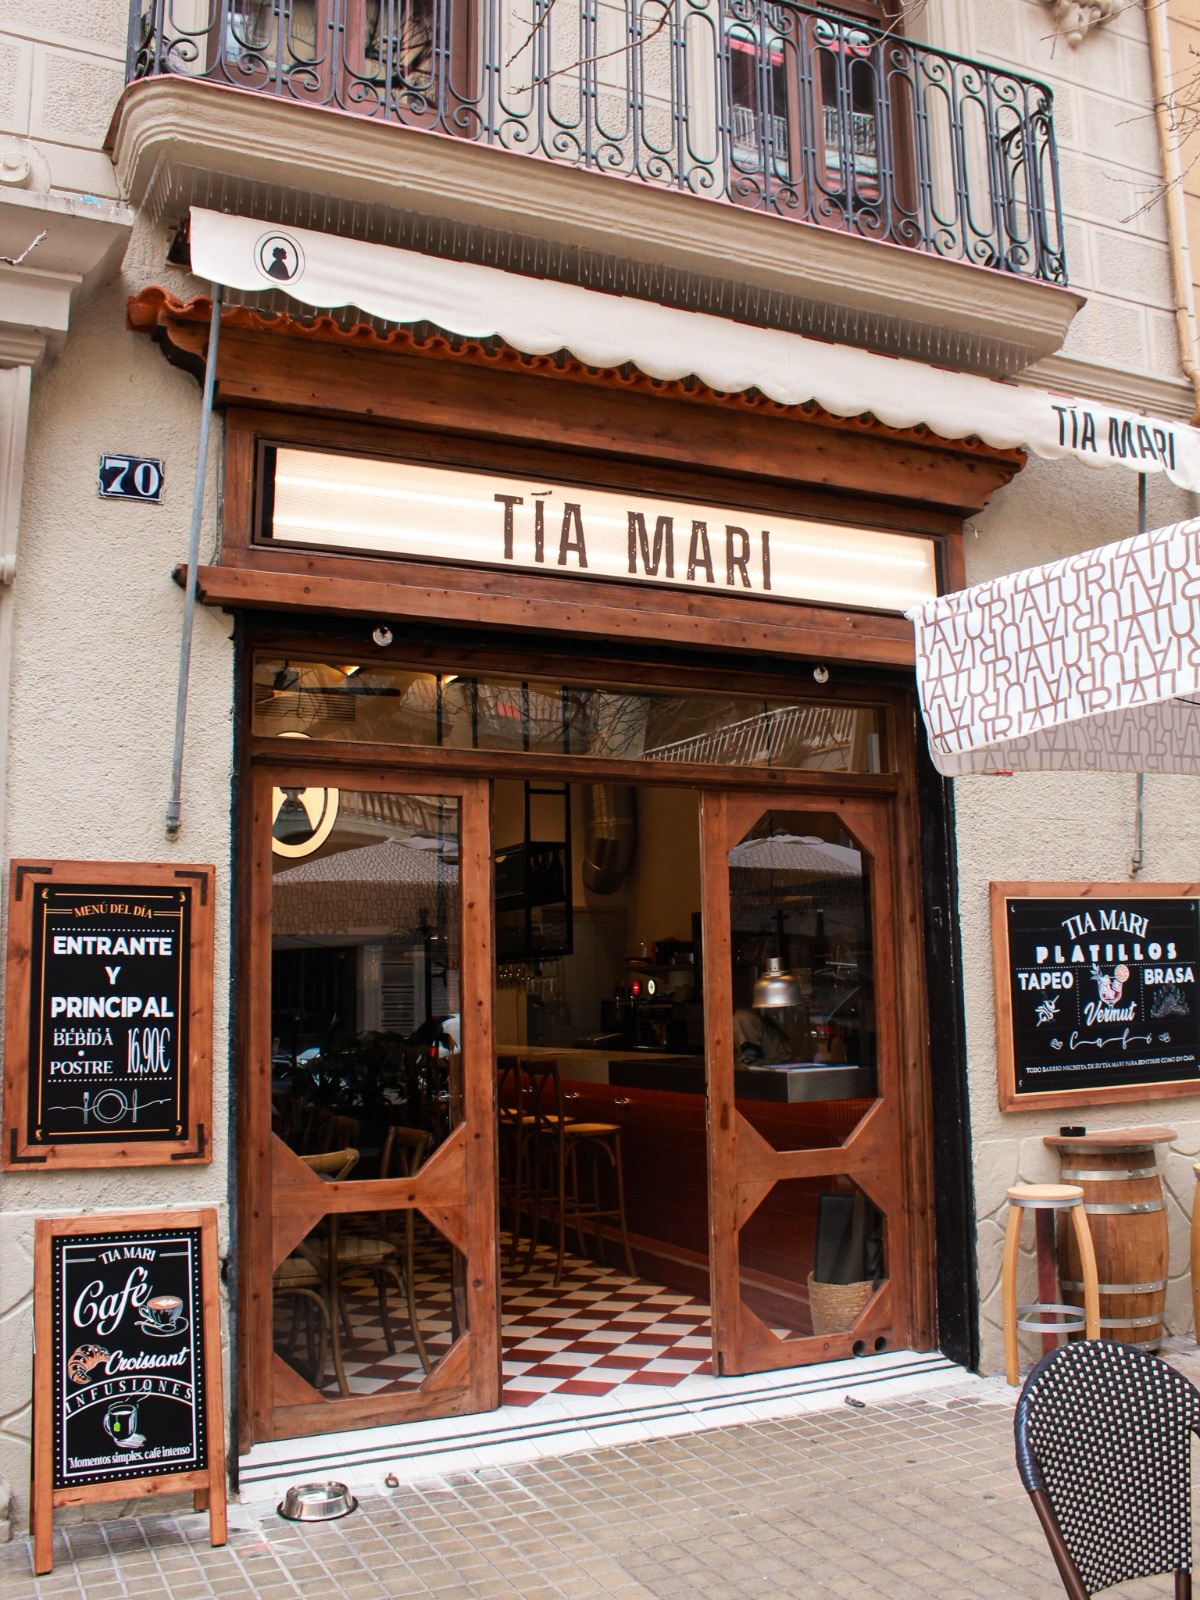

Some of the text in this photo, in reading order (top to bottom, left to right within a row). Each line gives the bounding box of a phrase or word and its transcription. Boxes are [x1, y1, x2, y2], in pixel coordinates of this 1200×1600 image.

[1051, 405, 1175, 470] TÍA MARI
[105, 459, 159, 496] 70
[494, 490, 771, 590] TÍA MARI
[74, 901, 152, 918] MENÚ DEL DÍA
[1061, 909, 1149, 940] TIA MARI
[53, 935, 172, 956] ENTRANTE
[1036, 942, 1177, 964] PLATILLOS
[105, 966, 121, 985] Y
[1018, 971, 1074, 990] TAPEO
[1144, 967, 1195, 985] BRASA
[51, 996, 174, 1018] PRINCIPAL
[1084, 1001, 1137, 1026] Vermut
[53, 1032, 114, 1046] BEBIDA
[127, 1027, 171, 1076] 16,90€
[50, 1060, 114, 1075] POSTRE
[1042, 1065, 1062, 1073] BARRIO
[1063, 1064, 1086, 1072] NECESITA
[1138, 1058, 1160, 1066] SENTIRSE
[98, 1246, 156, 1265] TIA MARI
[73, 1266, 150, 1336] Café
[105, 1346, 190, 1375] Croissant
[66, 1379, 193, 1414] INFUSIONES
[144, 1447, 161, 1460] café
